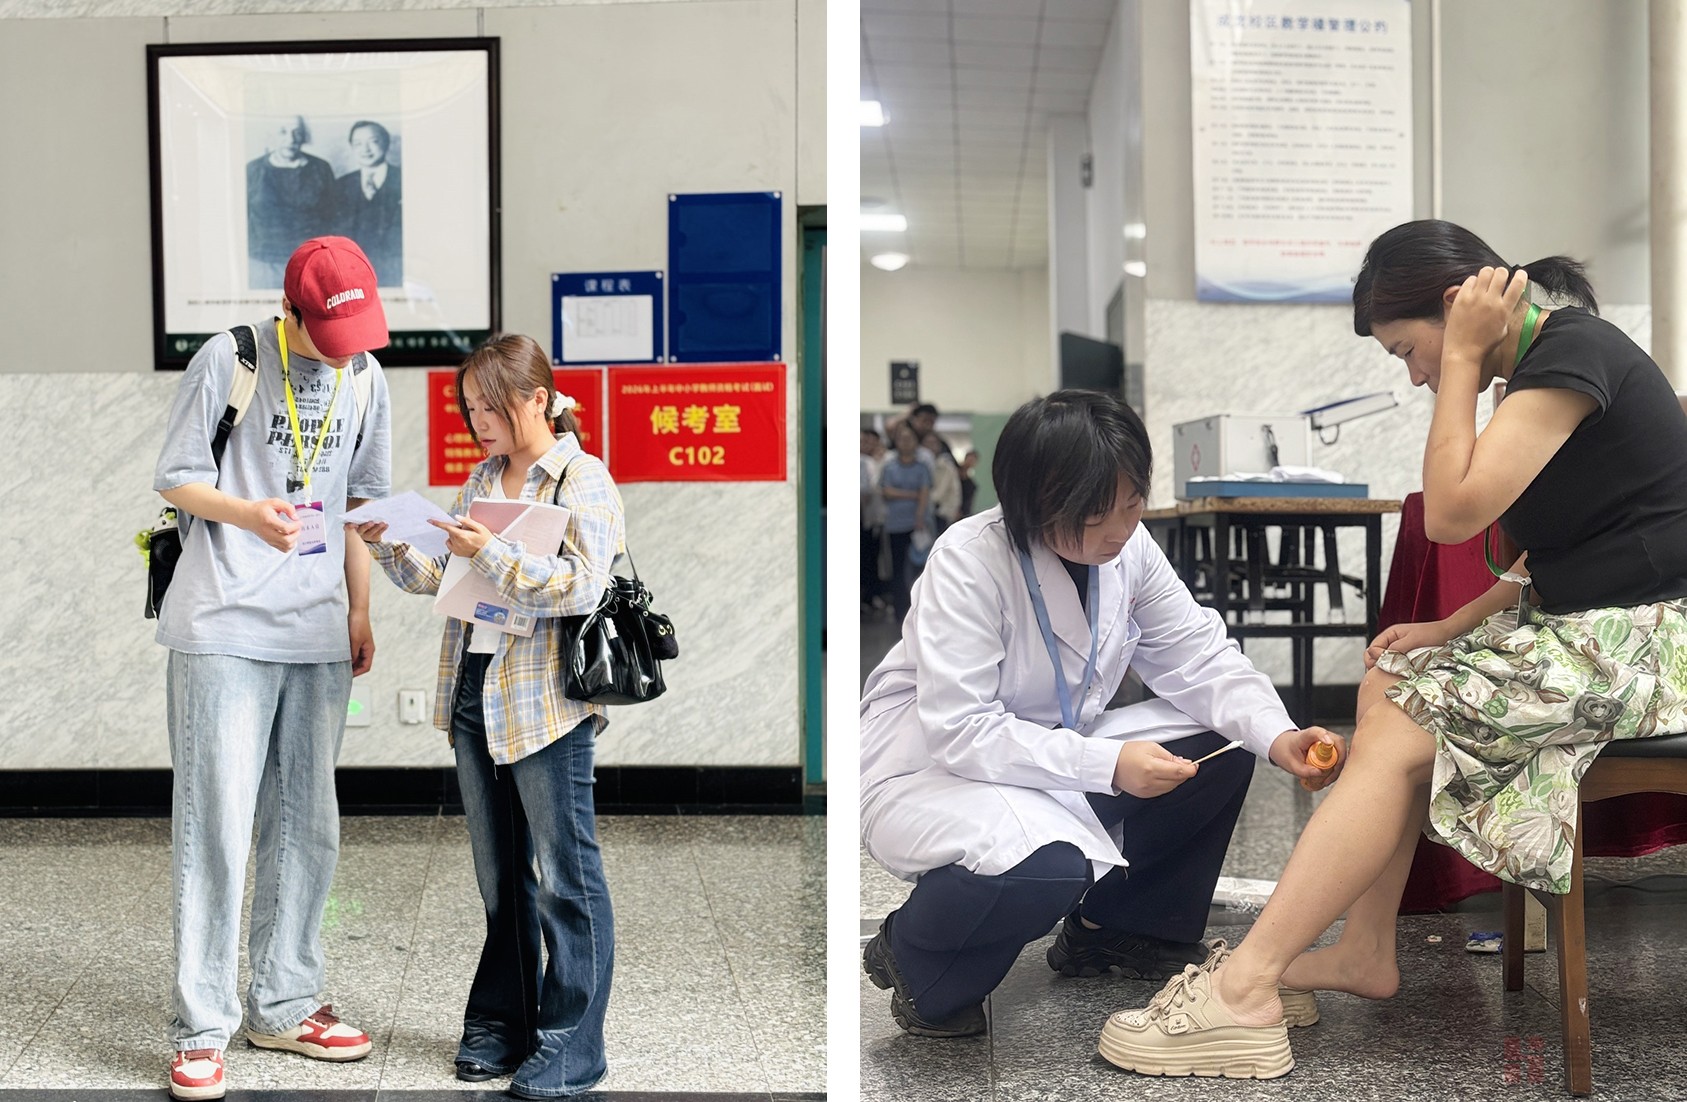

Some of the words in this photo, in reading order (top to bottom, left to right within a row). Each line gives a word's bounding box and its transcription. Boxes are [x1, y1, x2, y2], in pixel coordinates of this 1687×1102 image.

[584, 278, 632, 293] 课程表
[326, 288, 365, 309] COLORADO
[650, 403, 742, 435] 候考室
[668, 446, 725, 465] C102
